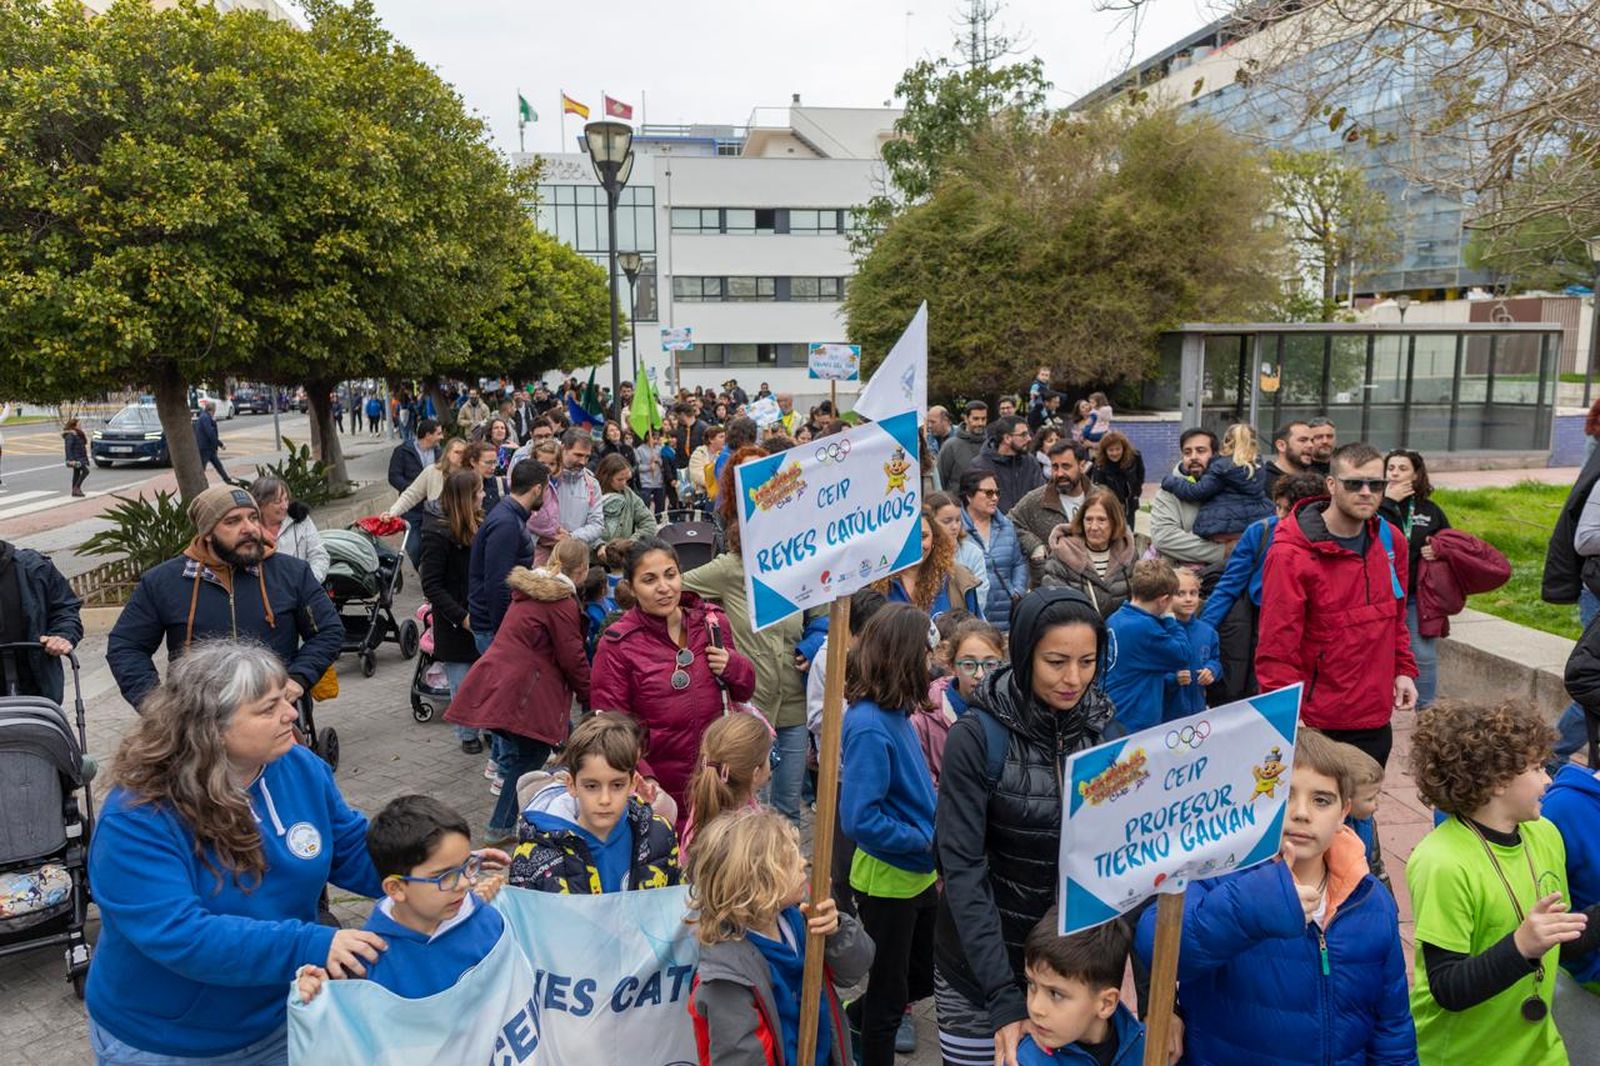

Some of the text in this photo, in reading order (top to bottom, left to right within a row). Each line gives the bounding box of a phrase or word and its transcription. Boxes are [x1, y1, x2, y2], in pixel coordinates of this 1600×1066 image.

[816, 477, 851, 509] CEIP
[756, 490, 916, 574] REYES CATÓLICOS
[1163, 756, 1208, 791] CEIP
[1093, 803, 1256, 878] TIERNO GALVÁN
[1124, 783, 1233, 843] PROFESOR
